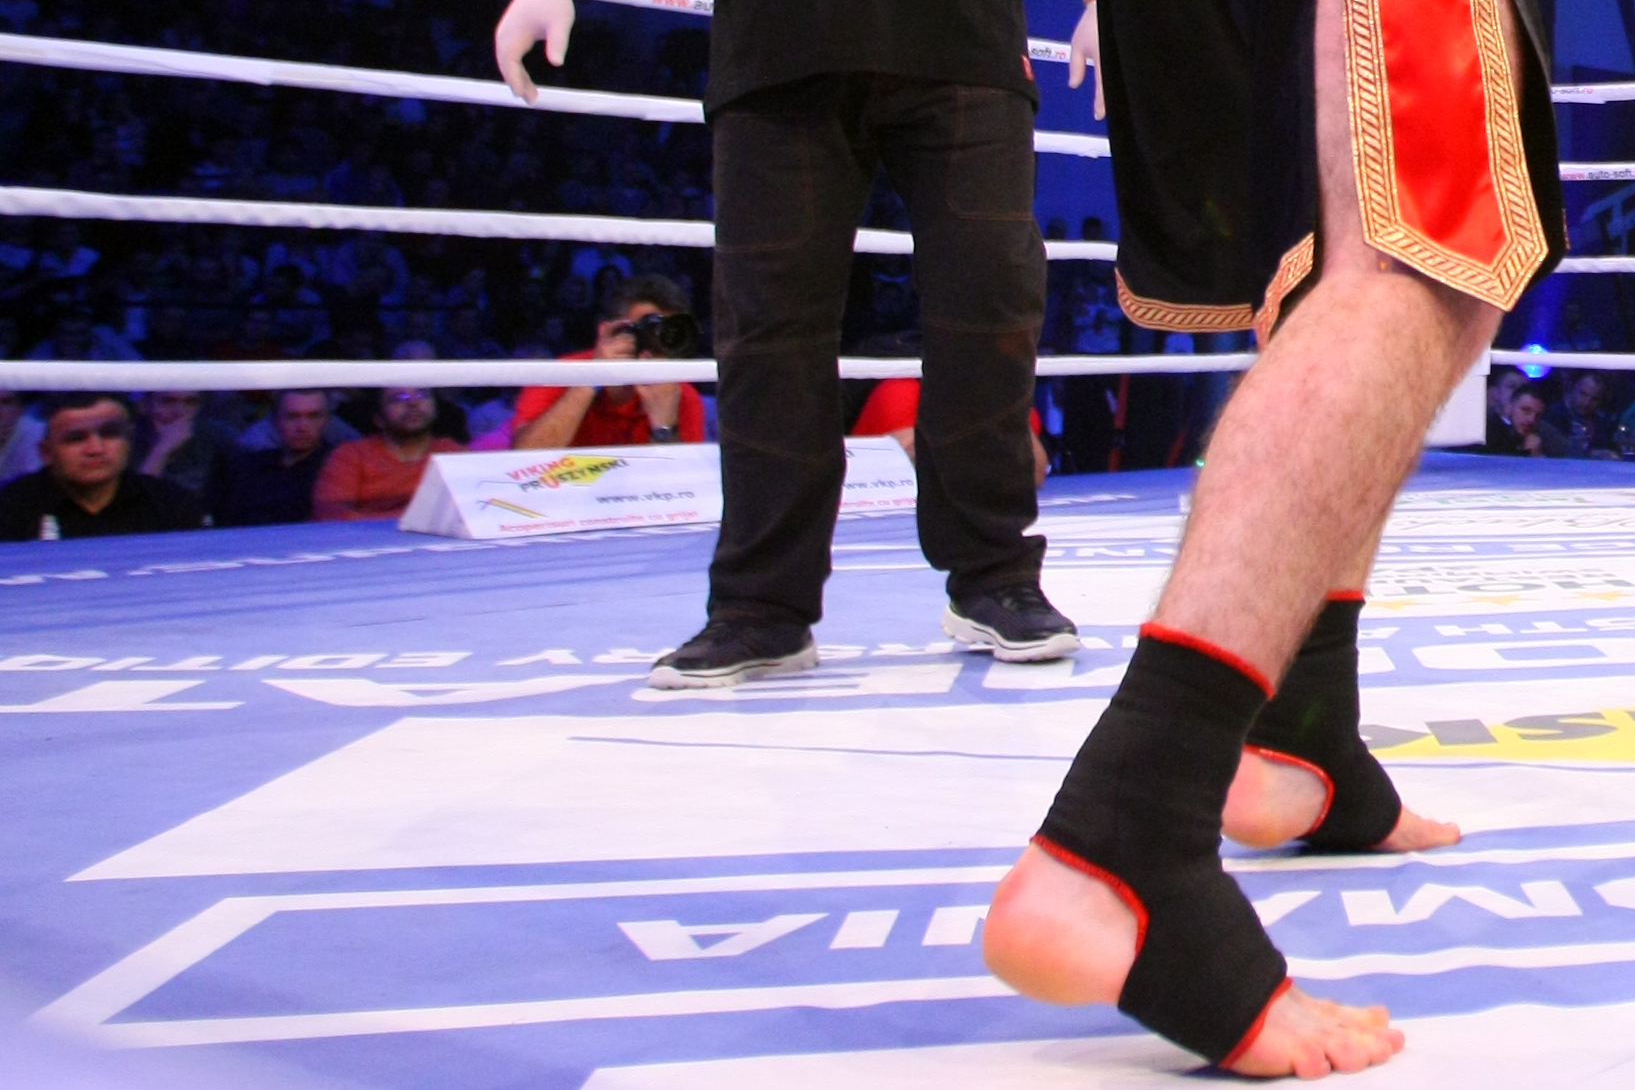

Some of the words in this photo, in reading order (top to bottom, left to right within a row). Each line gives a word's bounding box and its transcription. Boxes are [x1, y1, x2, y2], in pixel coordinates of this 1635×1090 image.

[506, 455, 576, 481] VIKING
[595, 490, 695, 505] www.vkp.ro
[0, 652, 473, 672] EDITIO
